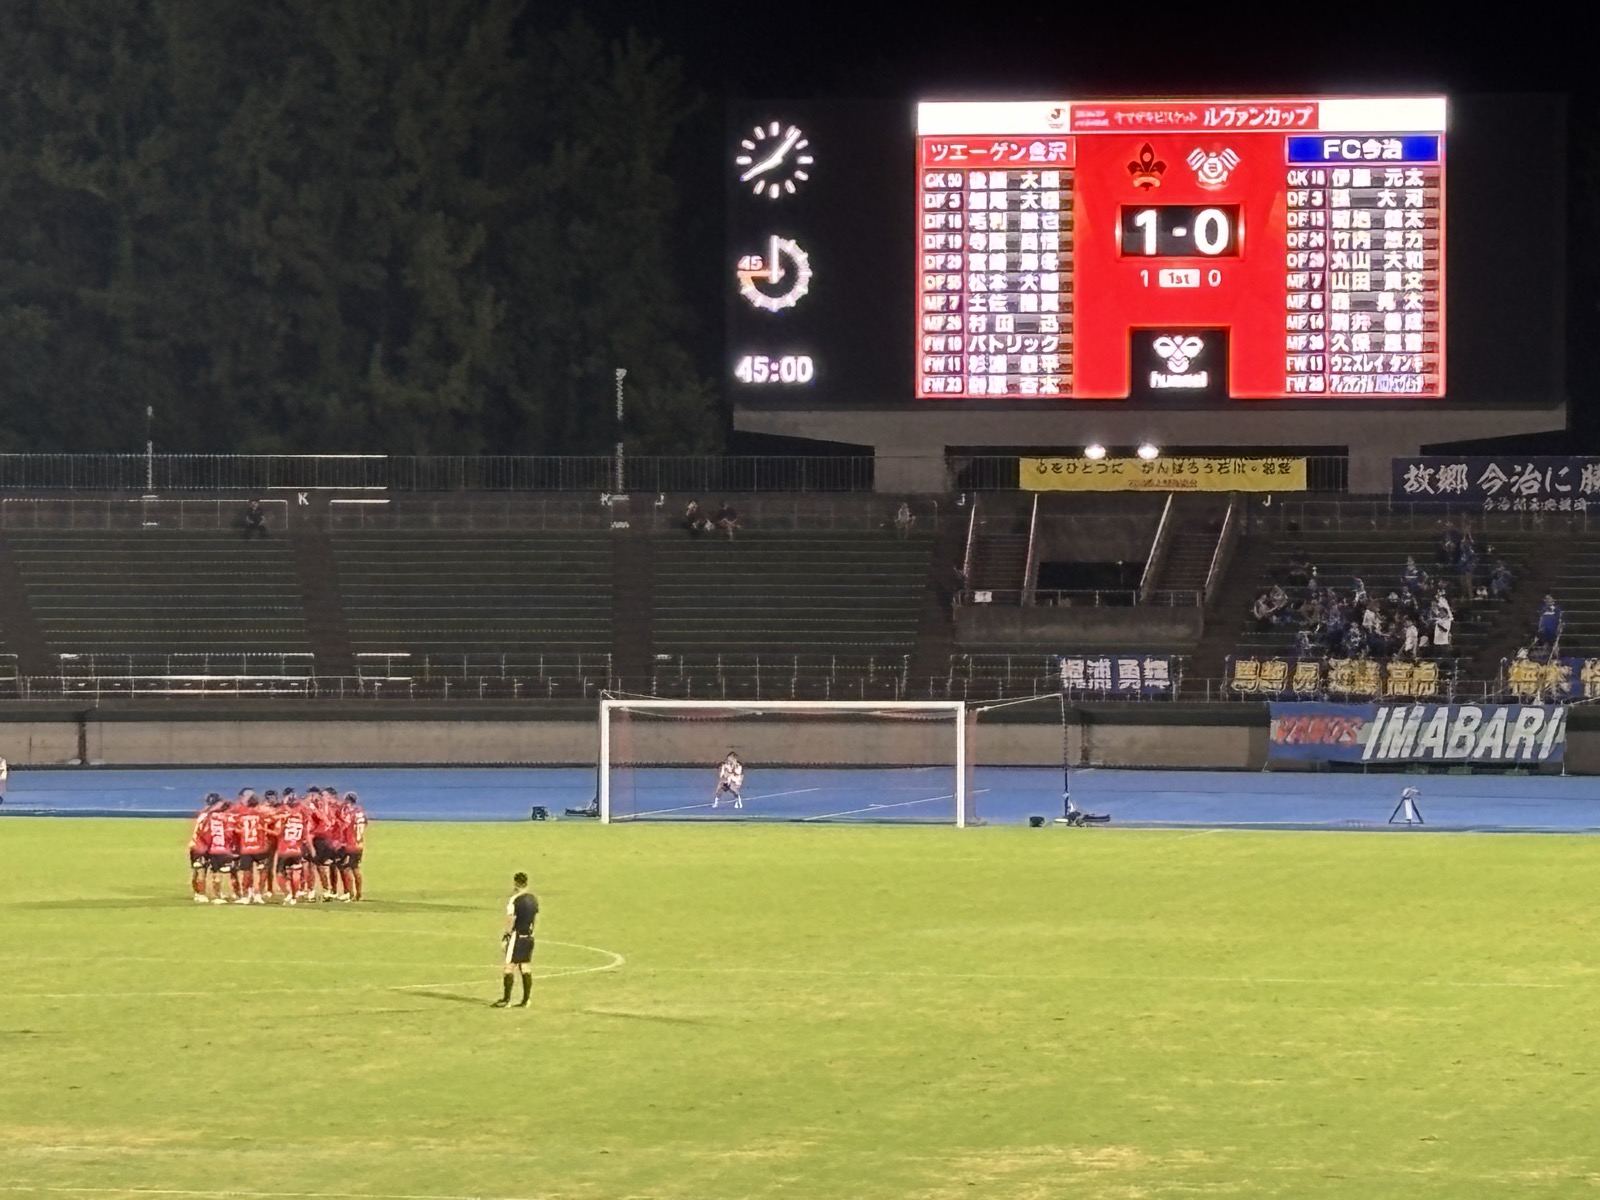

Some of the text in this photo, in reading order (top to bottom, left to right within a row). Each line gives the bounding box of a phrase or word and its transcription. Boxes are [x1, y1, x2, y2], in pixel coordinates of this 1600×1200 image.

[1204, 105, 1313, 127] ルヴァンカップ
[931, 141, 1067, 162] ツエーゲン金沢
[1323, 139, 1402, 160] FC今治
[1140, 269, 1221, 287] 1 1st 0
[1312, 273, 1326, 290] 7
[1331, 271, 1371, 291] 山田
[949, 296, 962, 311] 7
[969, 335, 1059, 353] パトリック
[735, 355, 814, 383] 45:00
[1403, 463, 1469, 495] 故郷
[298, 492, 309, 506] K
[1361, 705, 1566, 760] IMABARI
